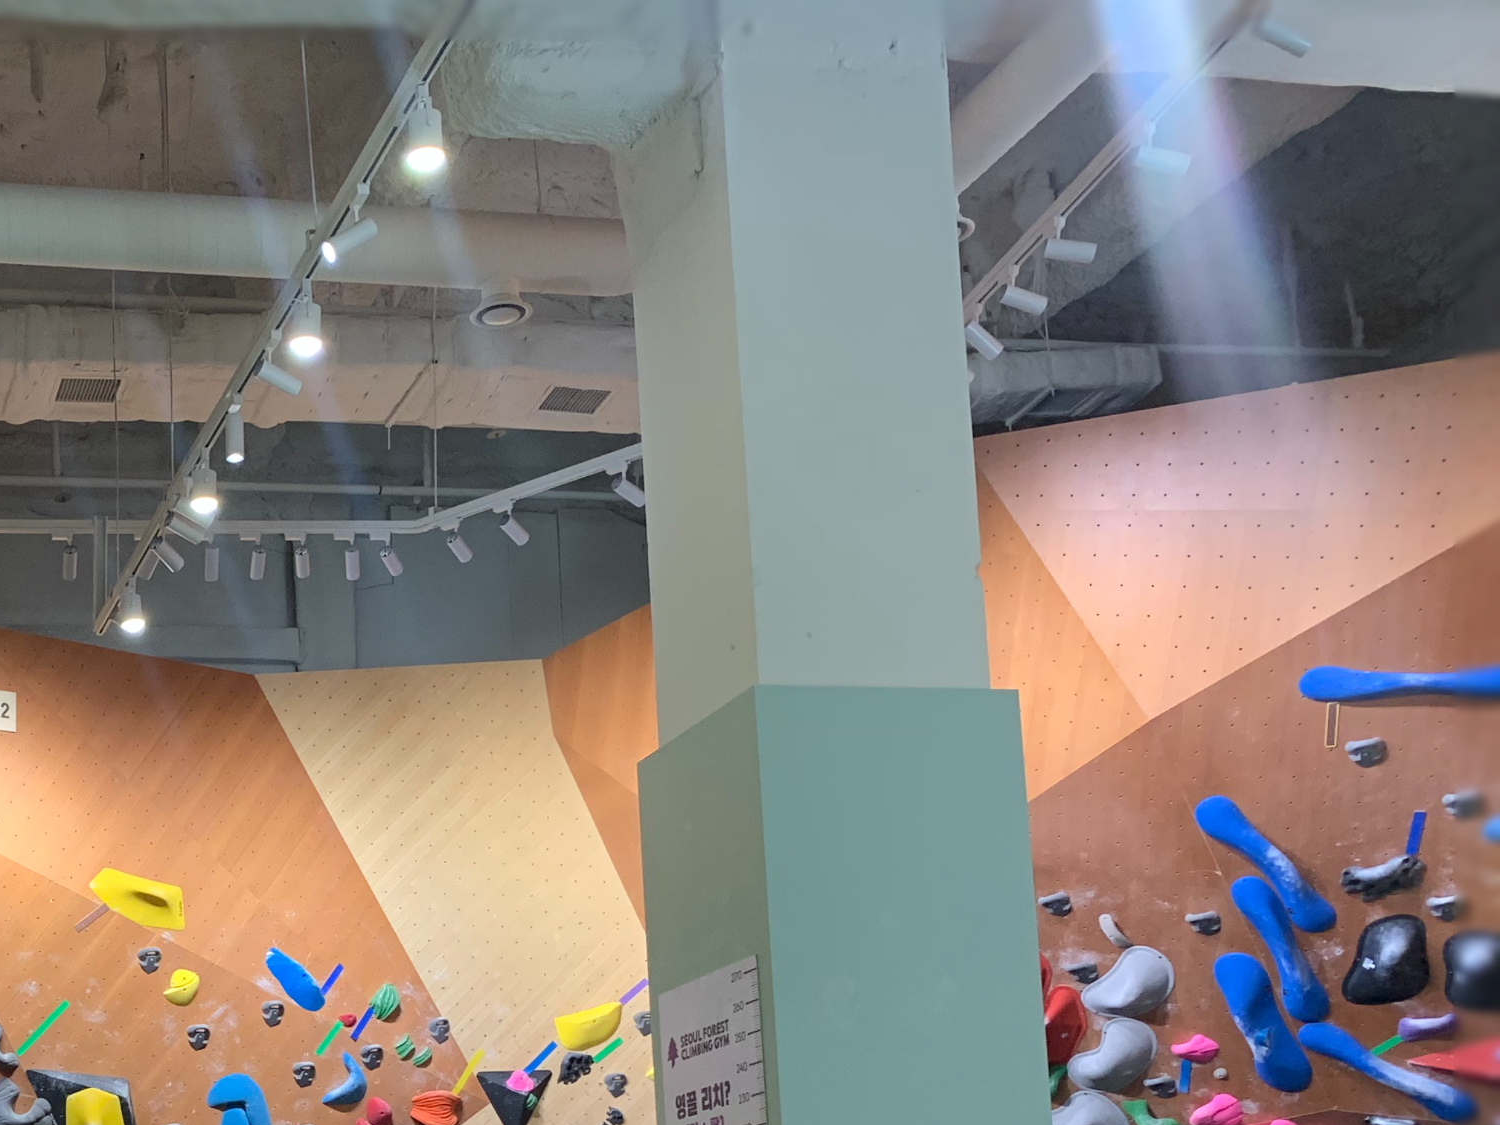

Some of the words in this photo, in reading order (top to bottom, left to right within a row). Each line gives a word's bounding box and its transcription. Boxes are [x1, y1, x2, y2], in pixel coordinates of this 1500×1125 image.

[731, 970, 743, 983] 270
[733, 1000, 745, 1013] 260
[680, 1028, 702, 1048] SEOUL
[703, 1019, 729, 1039] FOREST
[735, 1031, 747, 1043] 250
[681, 1039, 713, 1060] CLIMBING
[714, 1034, 730, 1049] GYM
[736, 1061, 748, 1074] 240
[675, 1090, 698, 1120] 영끌
[701, 1080, 731, 1111] 리치?
[738, 1092, 750, 1104] 230
